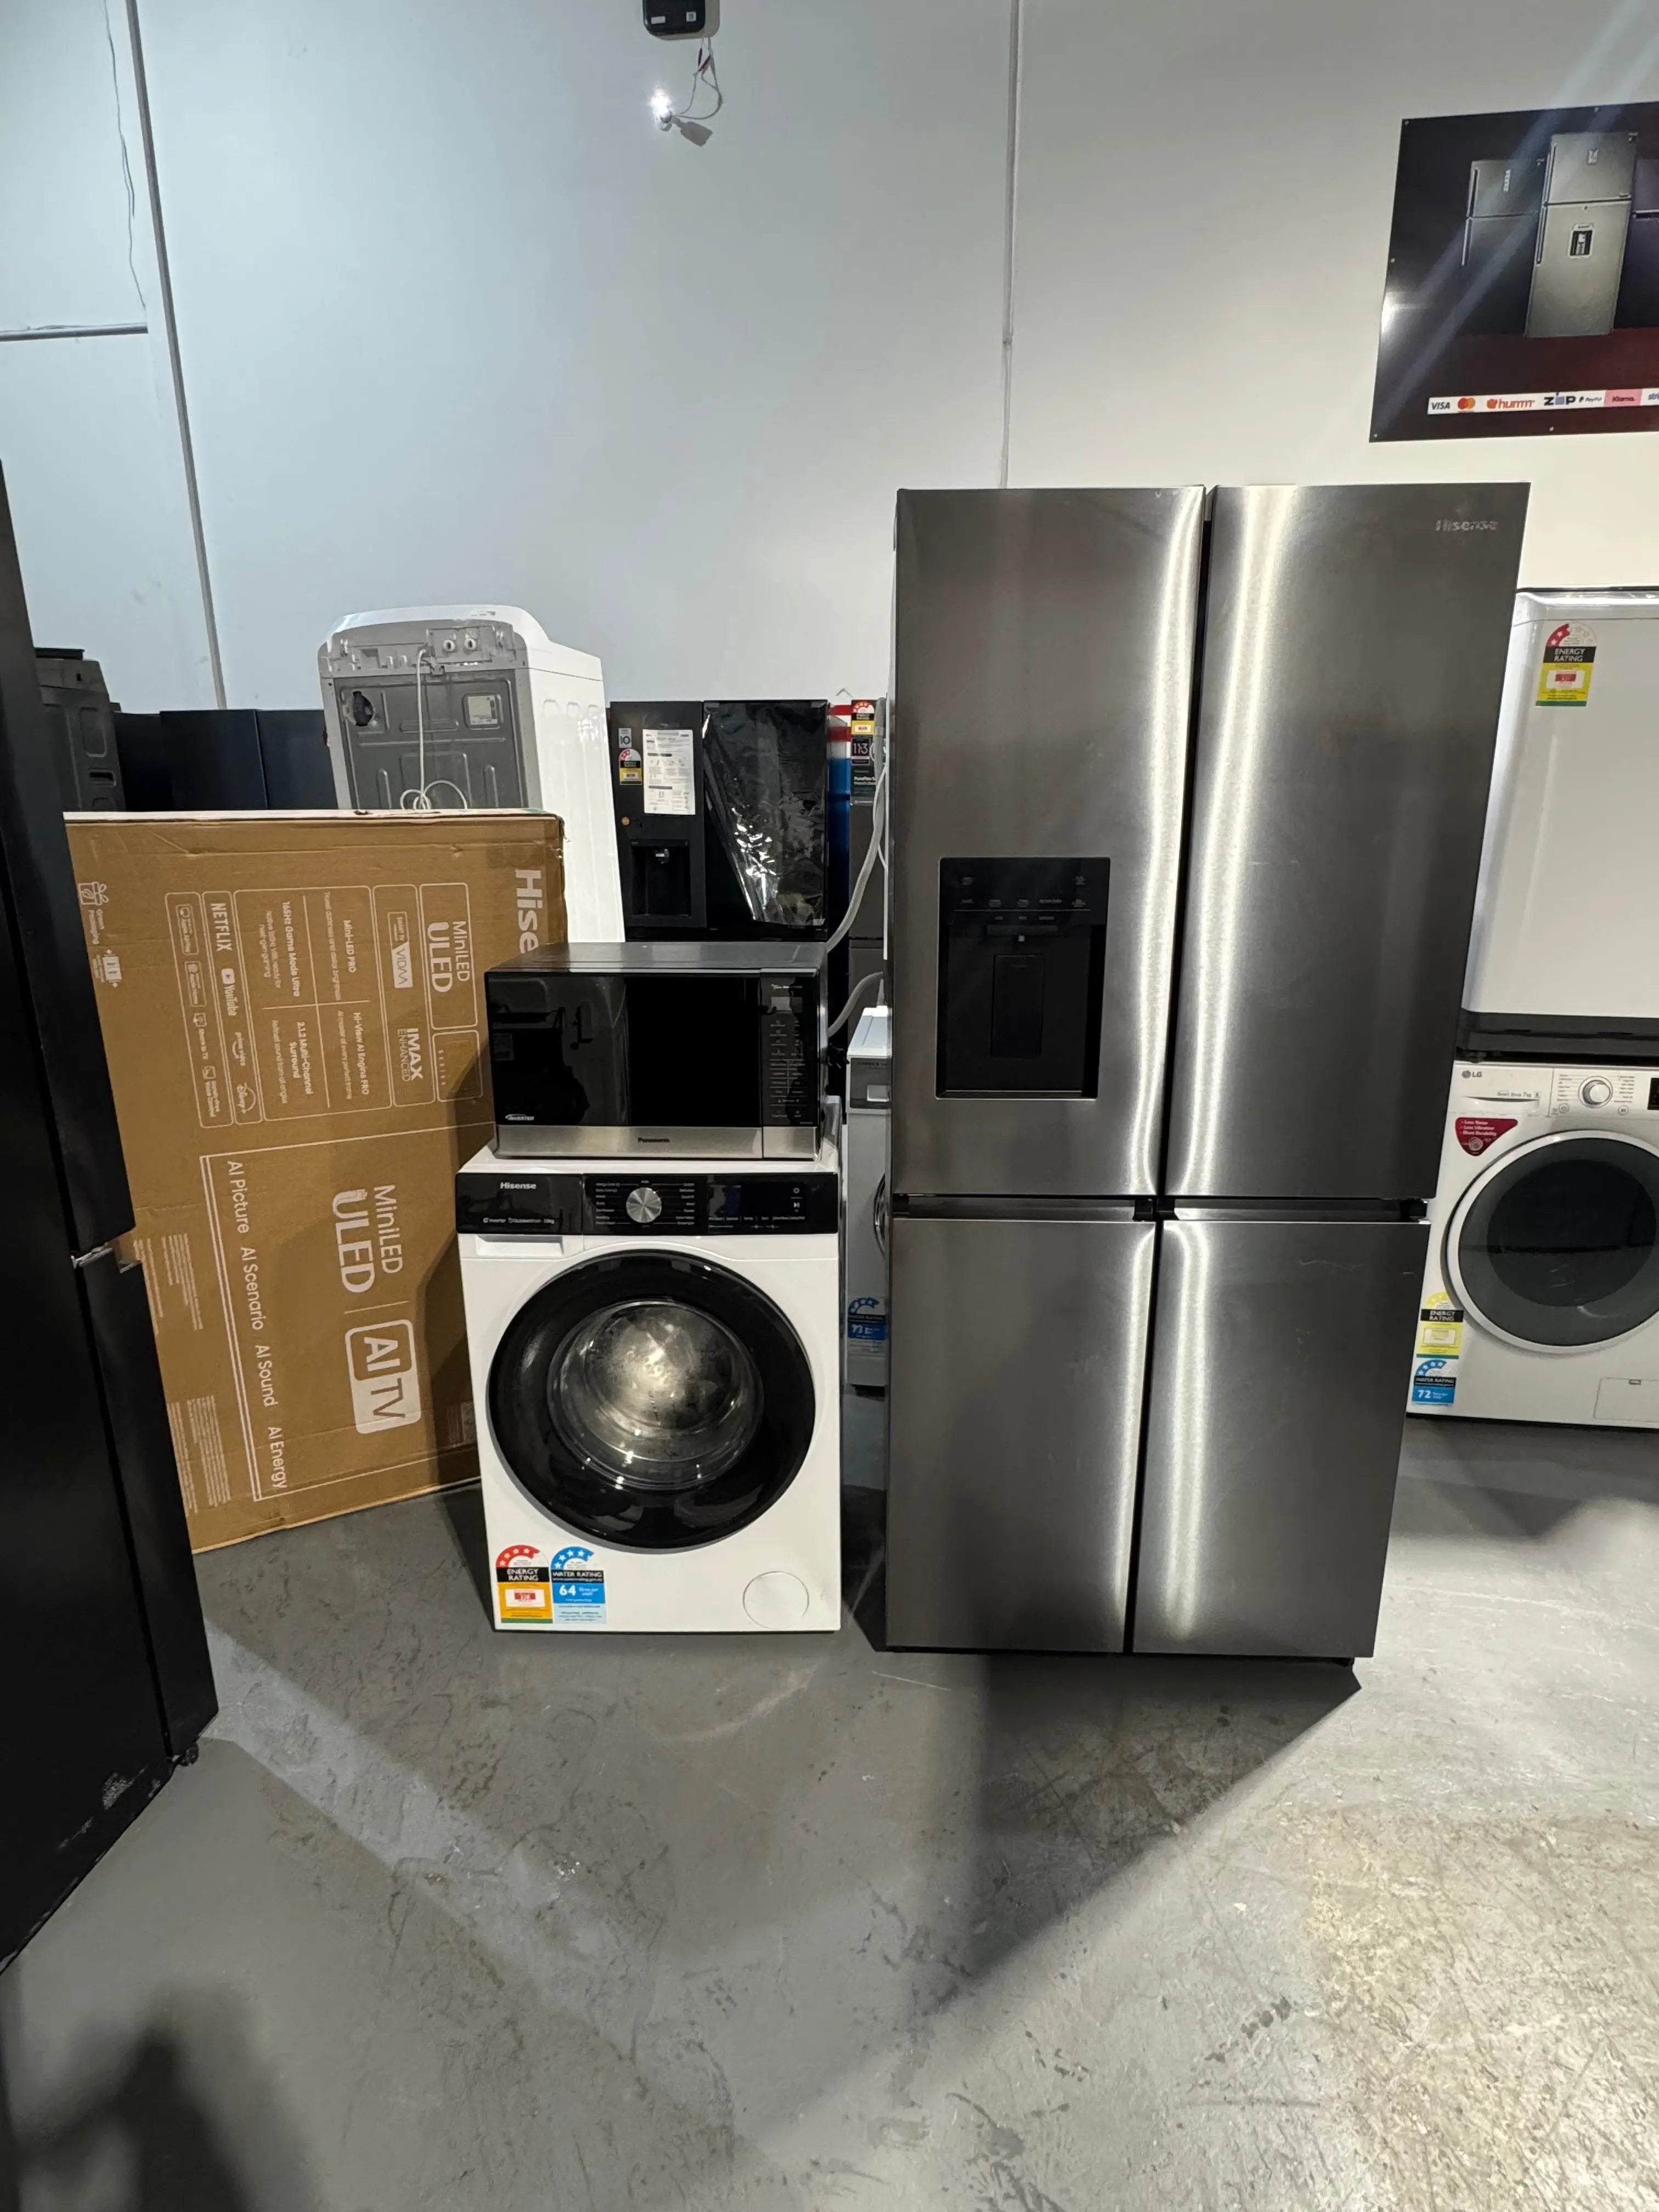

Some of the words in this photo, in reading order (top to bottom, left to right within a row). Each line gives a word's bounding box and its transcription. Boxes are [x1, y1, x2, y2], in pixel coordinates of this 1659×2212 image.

[1435, 520, 1498, 531] Hisense
[210, 903, 233, 951] NETFLIX
[282, 901, 291, 924] 165Hz
[285, 926, 295, 951] Game
[343, 920, 354, 955] Mini-LED
[452, 921, 470, 981] MiniLED
[288, 953, 298, 975] Mode
[347, 957, 356, 973] PRO
[427, 922, 453, 992] ULED
[224, 985, 239, 1015] YouTube
[291, 977, 301, 997] Ultra
[235, 1032, 244, 1049] prime
[297, 1022, 307, 1038] 2.1.2
[353, 1012, 364, 1042] Hi-View
[277, 1062, 285, 1076] from
[289, 1042, 301, 1078] Surround
[298, 1039, 314, 1094] Multi-Channel
[357, 1053, 368, 1078] Engine
[397, 1029, 410, 1081] ENHANCED
[407, 1028, 423, 1081] IMAX
[360, 1080, 370, 1094] PRO
[228, 1161, 244, 1176] AI
[230, 1179, 250, 1234] Picture
[332, 1189, 375, 1293] ULED
[374, 1185, 403, 1273] MiniLED
[240, 1247, 257, 1261] AI
[243, 1263, 267, 1330] Scenario
[255, 1345, 271, 1359] AI
[364, 1337, 400, 1372] AI
[258, 1361, 279, 1407] Sound
[370, 1378, 406, 1418] TV
[1418, 1390, 1431, 1398] 72
[268, 1427, 283, 1439] AI
[269, 1441, 288, 1488] Energy
[559, 1584, 576, 1596] 64
